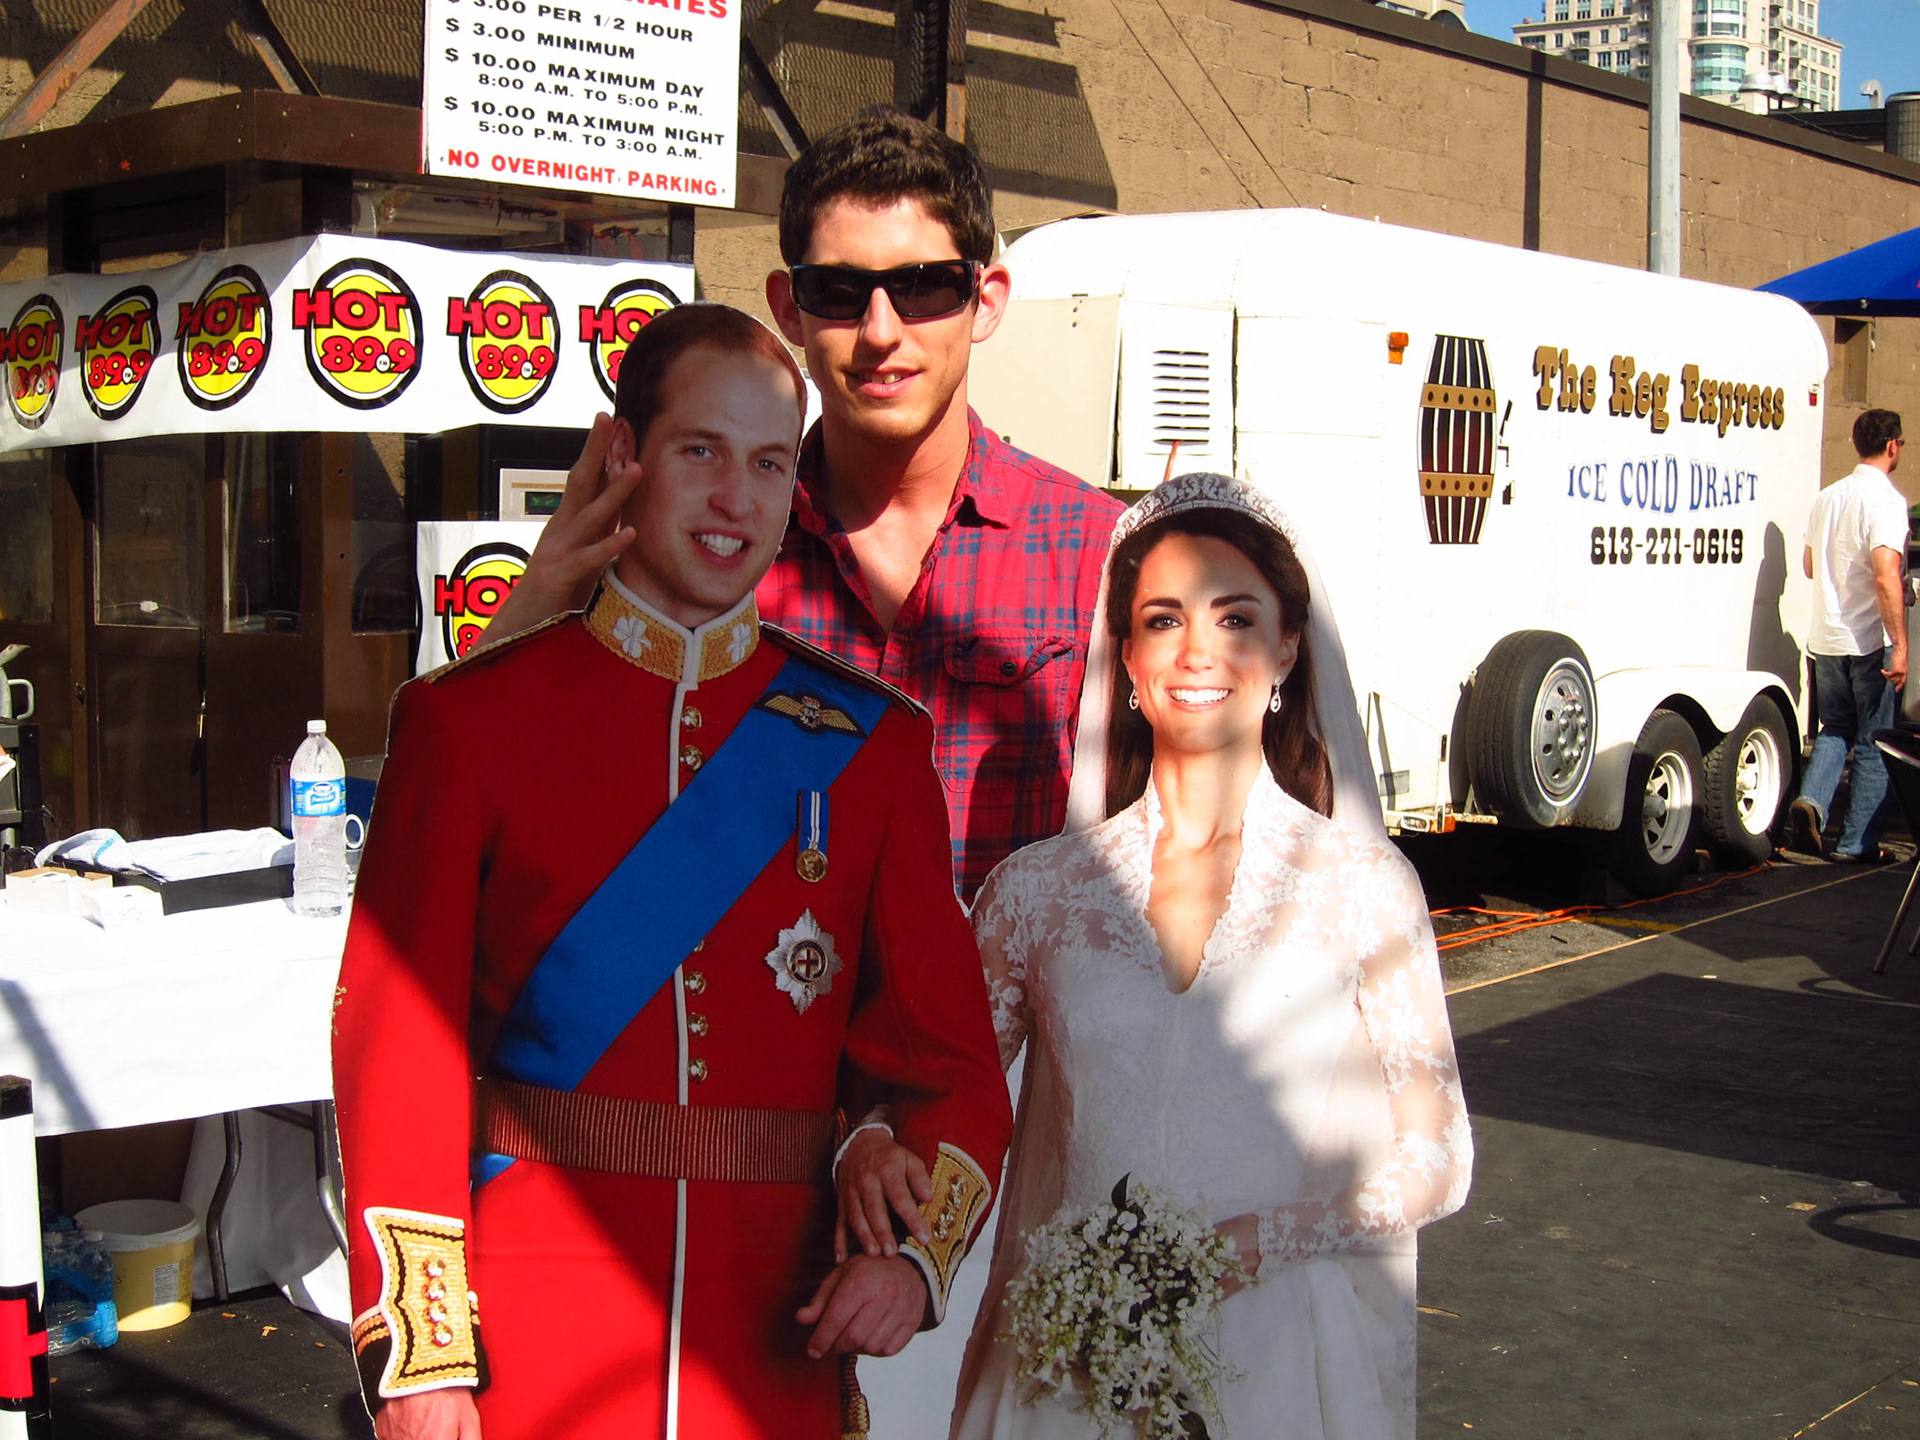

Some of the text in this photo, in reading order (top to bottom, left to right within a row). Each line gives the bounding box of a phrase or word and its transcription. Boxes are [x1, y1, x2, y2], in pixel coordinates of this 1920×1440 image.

[538, 4, 582, 23] PER
[593, 14, 625, 31] 1/2
[636, 21, 693, 42] HOUR
[625, 0, 727, 18] TES
[445, 17, 635, 60] $ 3.00 MINIMUM
[445, 47, 704, 98] $ 10.00 MAXIMUM DAY
[478, 73, 703, 116] 8:00 A.M. TO 5:00 P.M.
[444, 96, 725, 146] $ 10.00 MAXIMUM NIGHT
[478, 121, 703, 160] 5:00 P.M. TO 3:00 A.M.
[448, 149, 718, 196] NO OVERNIGHT PARKING
[74, 309, 152, 352] HOT
[174, 292, 264, 340] HOT
[292, 288, 409, 332] HOT
[446, 296, 550, 340] HOT
[578, 304, 668, 344] HO
[0, 320, 59, 363] HOT
[1532, 345, 1785, 438] The Keg Express
[1567, 455, 1759, 514] ICE COLD DRAFT
[1590, 526, 1744, 565] 613-271-0619
[434, 574, 524, 617] HO
